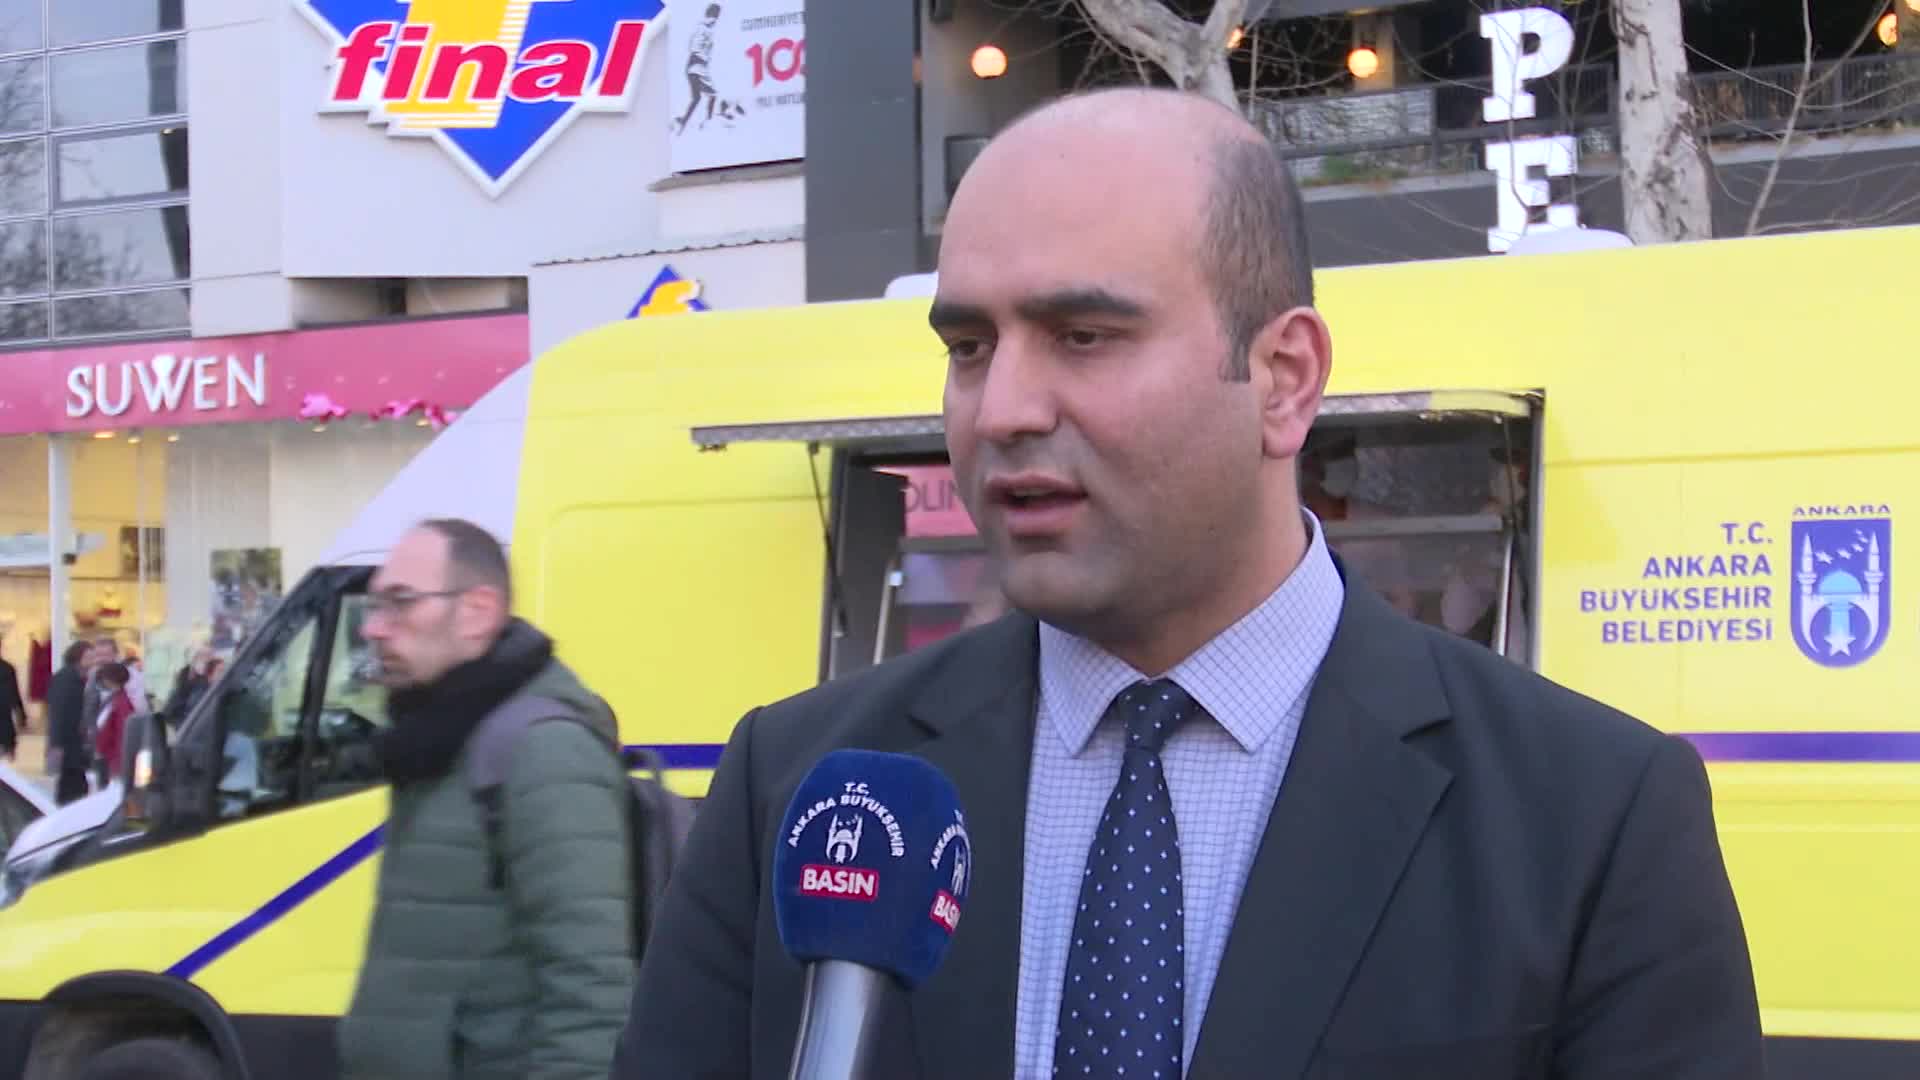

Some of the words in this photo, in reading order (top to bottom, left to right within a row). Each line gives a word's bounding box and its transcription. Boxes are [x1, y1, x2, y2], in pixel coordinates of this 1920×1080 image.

[332, 21, 648, 101] final
[65, 352, 266, 418] SUWEN
[1793, 504, 1890, 515] ANKARA
[1720, 521, 1773, 545] T.C.
[1642, 554, 1772, 579] ANKARA
[788, 797, 837, 848] ANKARA
[803, 868, 875, 896] BASIN
